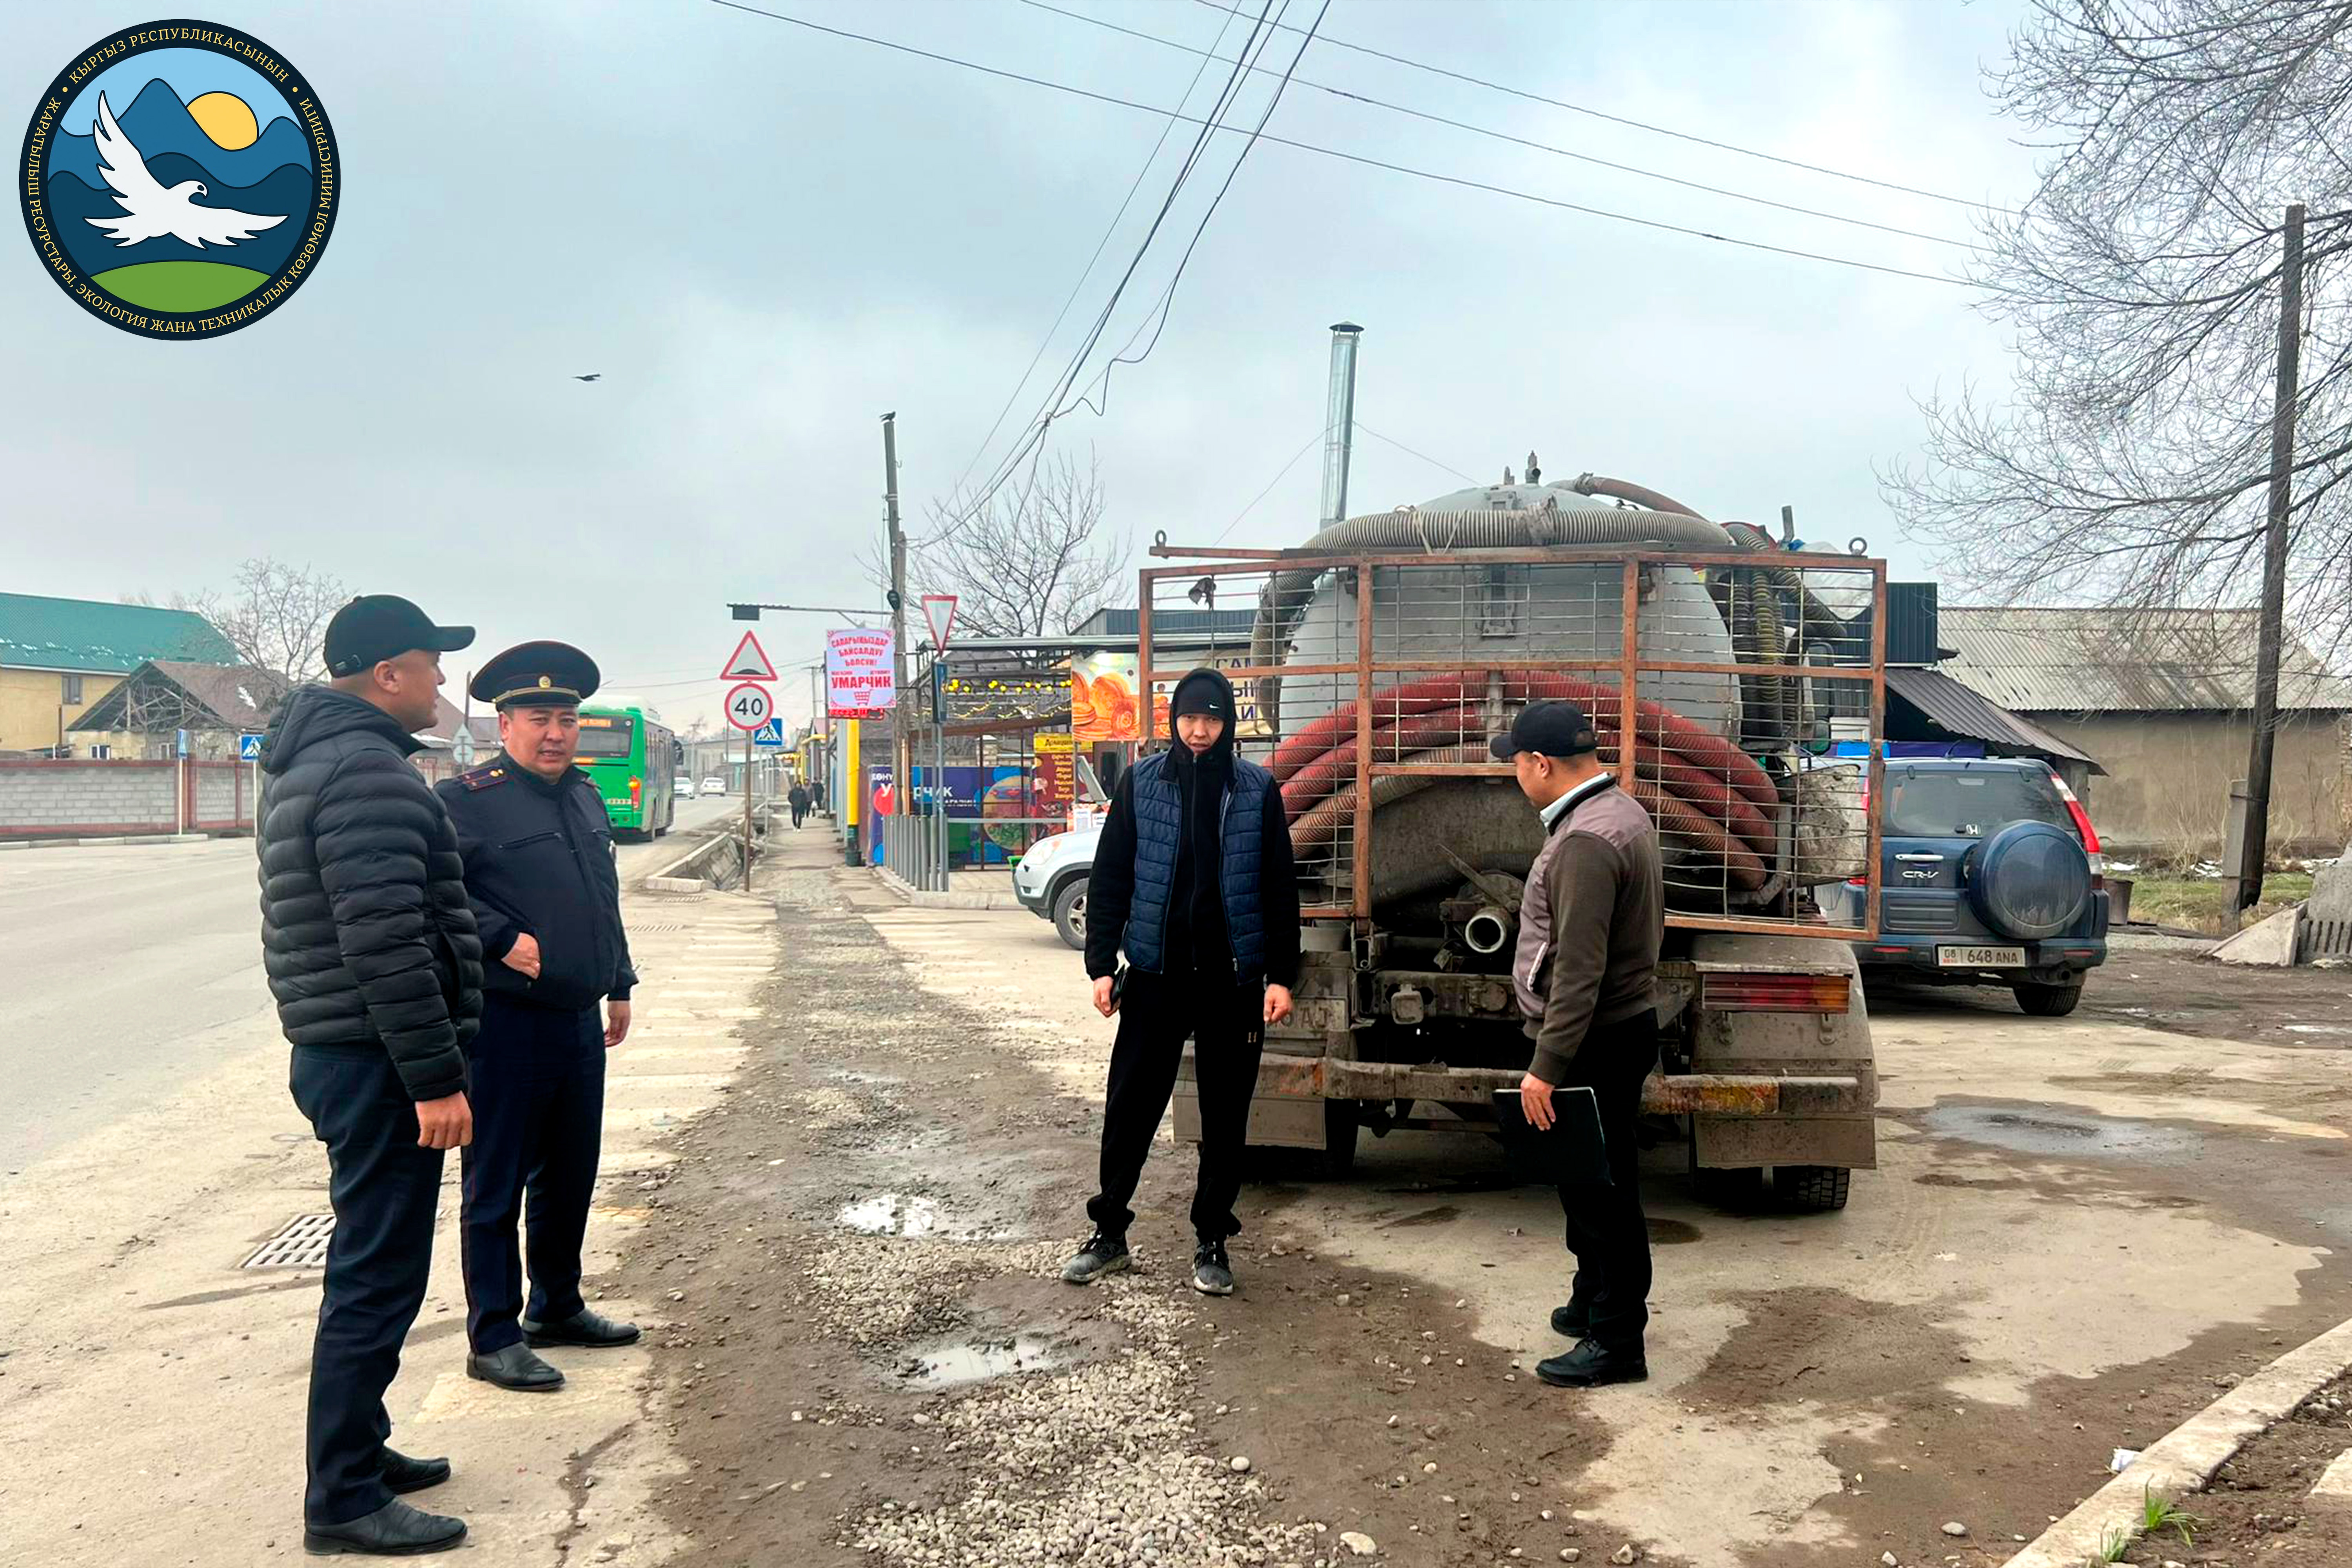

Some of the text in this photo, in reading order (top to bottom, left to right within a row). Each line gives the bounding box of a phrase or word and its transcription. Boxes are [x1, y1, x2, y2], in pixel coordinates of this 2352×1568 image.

[831, 676, 891, 688] УМАРЧИК
[734, 697, 763, 716] 40
[1967, 949, 1993, 963] 648
[1996, 952, 2018, 963] ANA
